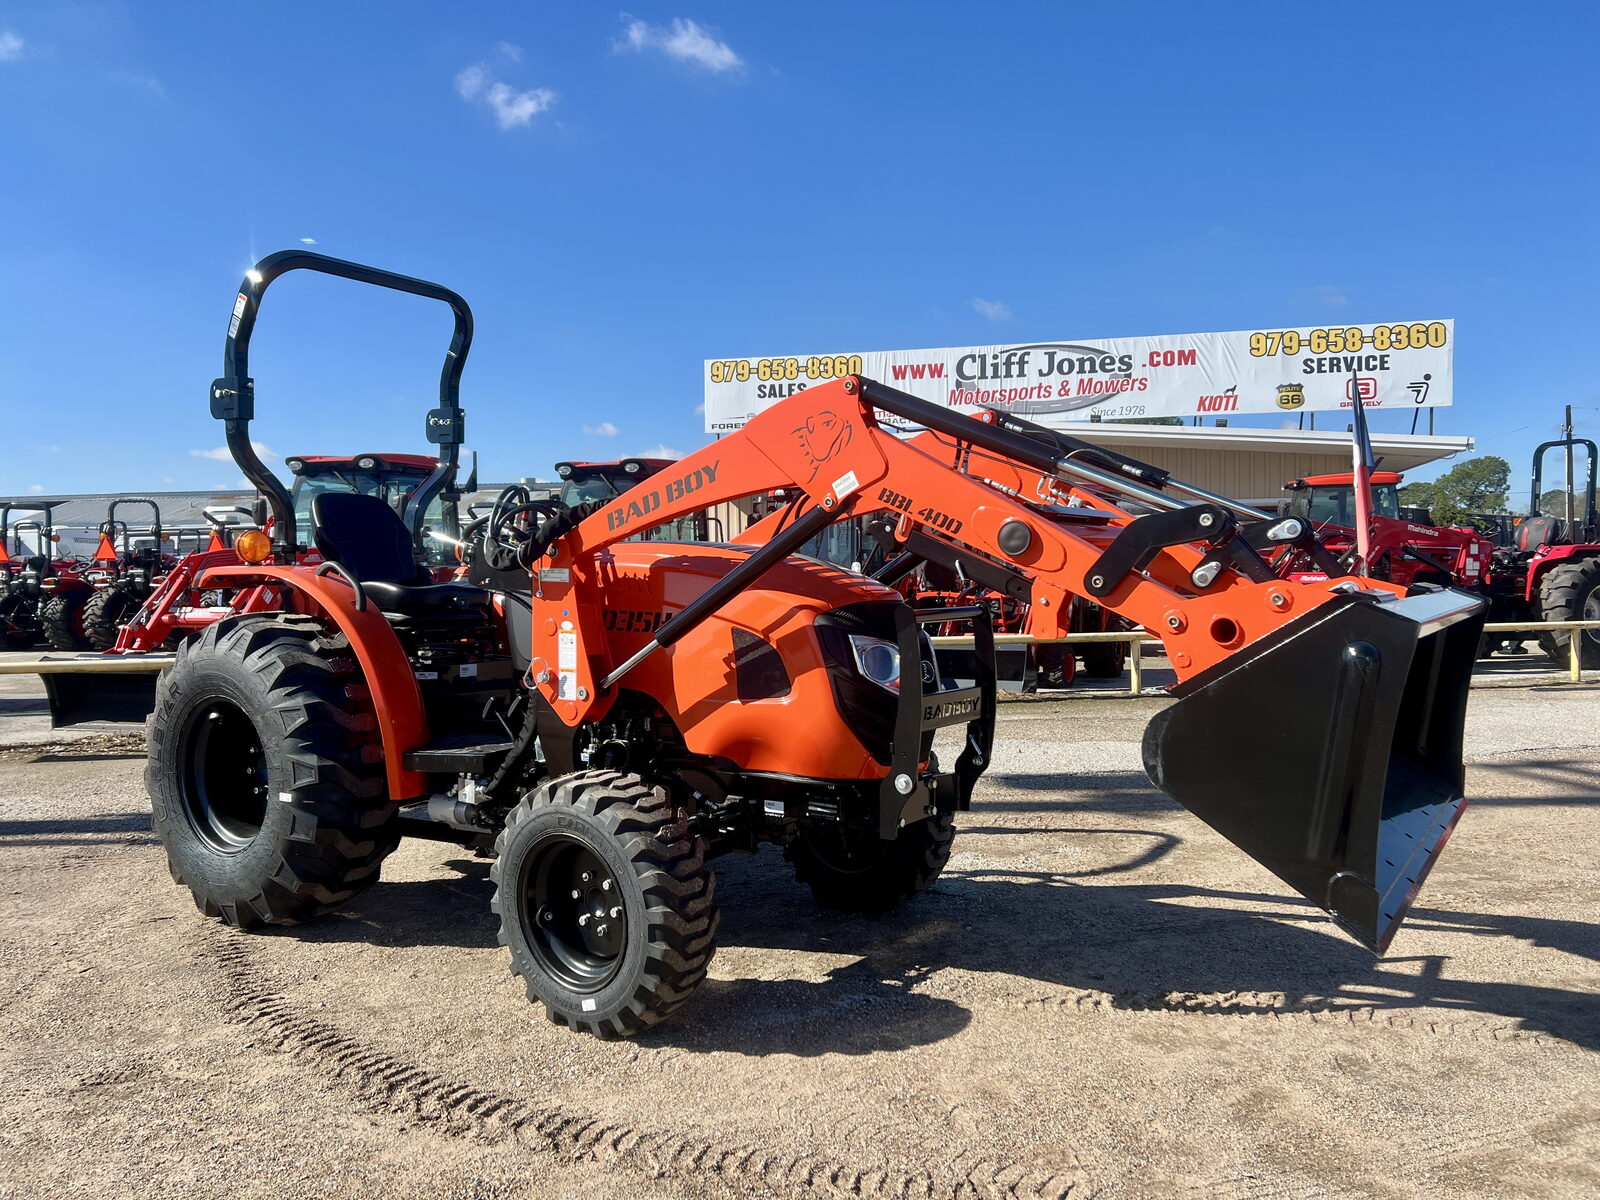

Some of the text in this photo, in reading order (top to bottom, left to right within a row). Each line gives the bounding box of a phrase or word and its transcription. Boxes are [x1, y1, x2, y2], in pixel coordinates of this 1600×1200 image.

[1249, 321, 1447, 358] 979-658-8360
[710, 355, 863, 384] 979-658-8360
[955, 351, 1031, 381] Cliff
[1037, 350, 1133, 378] Jones
[1141, 348, 1197, 368] .COM
[1302, 354, 1391, 375] SERVICE
[948, 377, 1149, 407] Motorsports & Mowers
[1196, 394, 1239, 413] KIOTI
[1280, 394, 1301, 405] 66
[1340, 400, 1383, 408] GRVELY
[1090, 405, 1146, 418] Since 1978
[607, 459, 720, 532] BAD BOY
[877, 487, 963, 535] BBL 400
